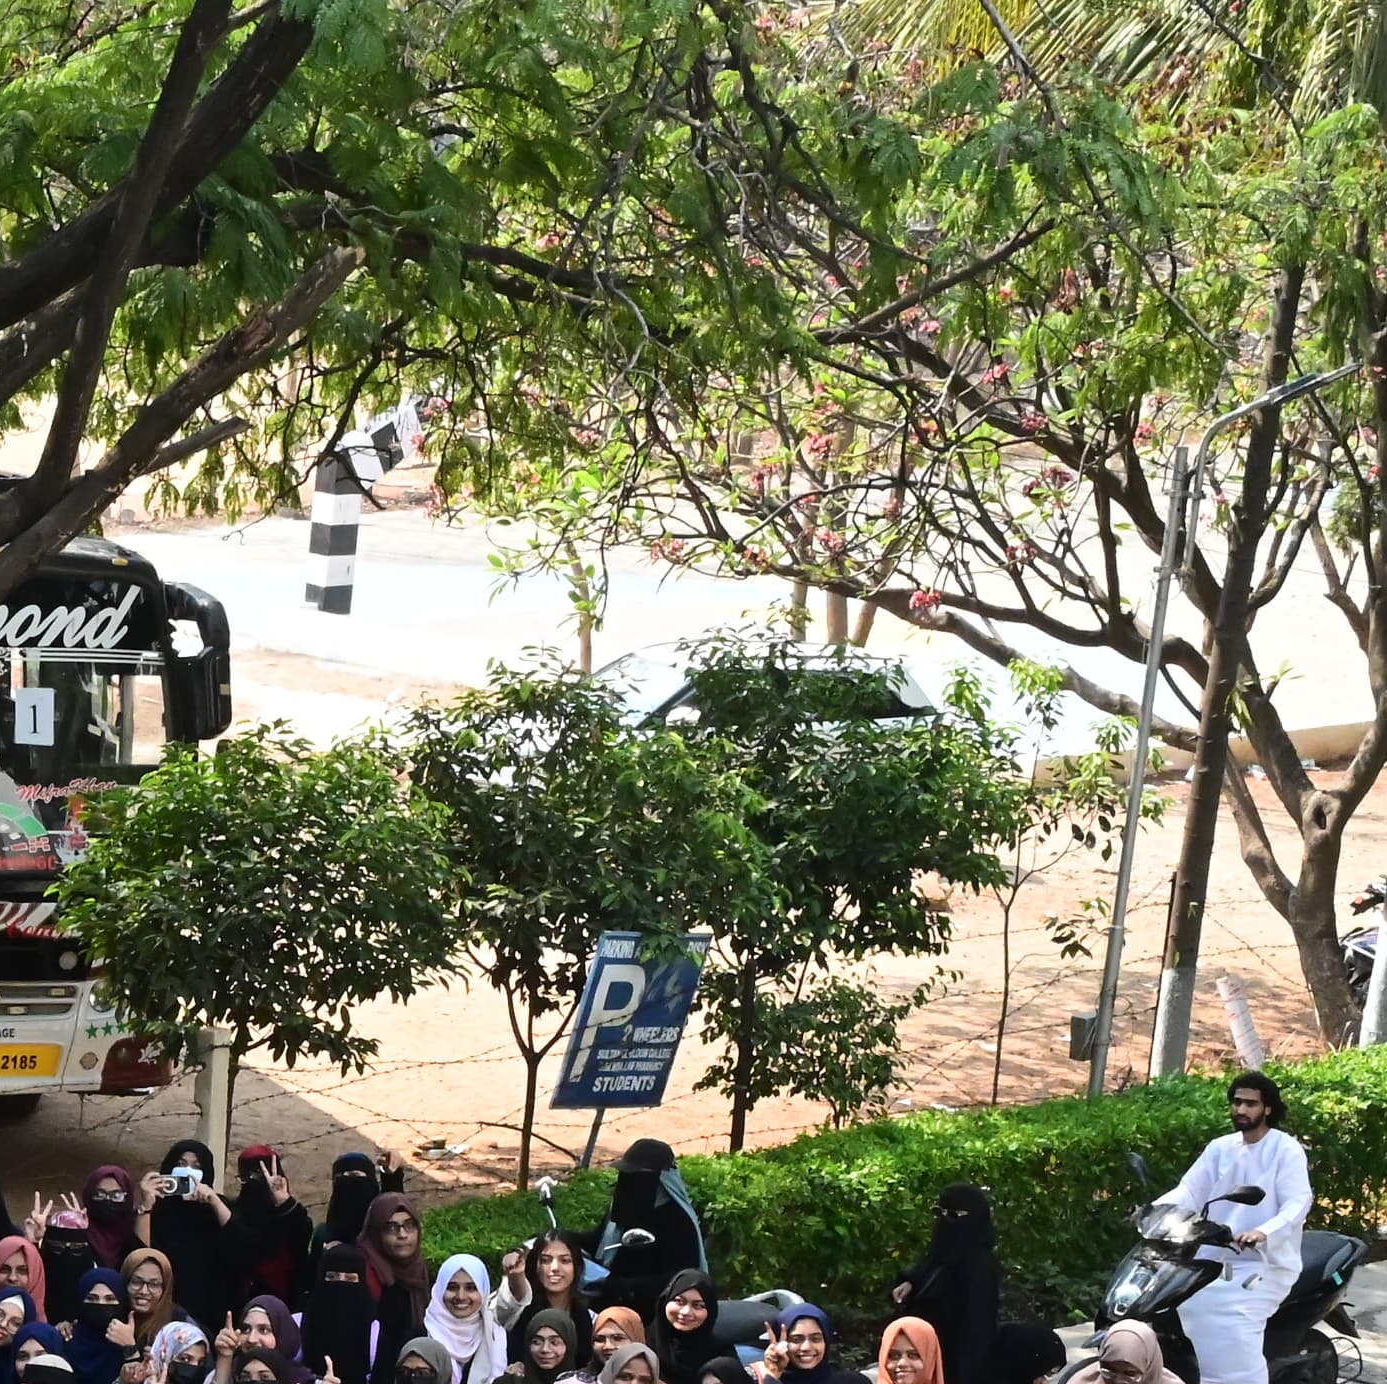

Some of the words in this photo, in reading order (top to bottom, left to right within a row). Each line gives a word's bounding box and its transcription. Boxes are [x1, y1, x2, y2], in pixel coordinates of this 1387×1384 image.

[28, 704, 39, 734] 1
[569, 964, 646, 1083] P
[633, 1026, 681, 1043] WHEELERS
[1, 1055, 37, 1070] 2185
[592, 1076, 656, 1093] STUDENTS
